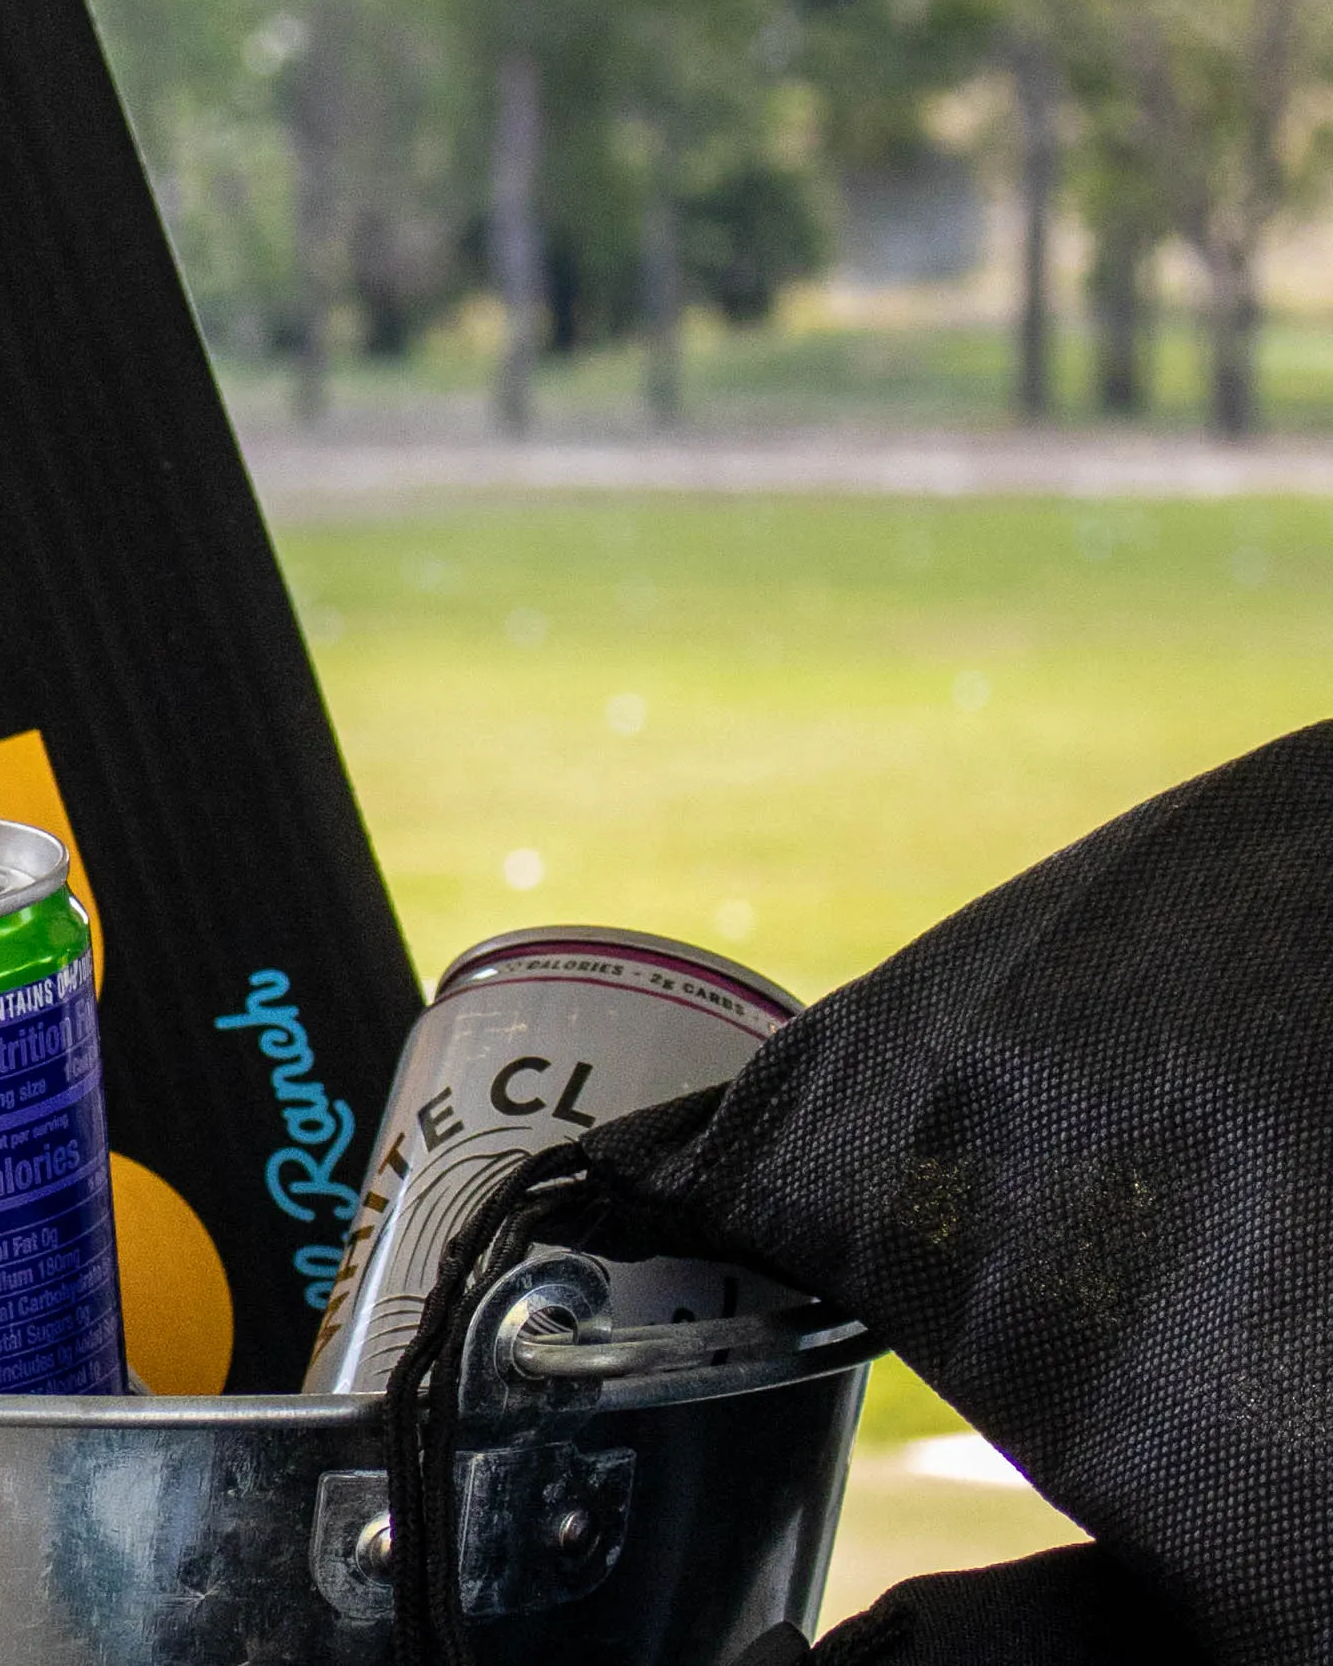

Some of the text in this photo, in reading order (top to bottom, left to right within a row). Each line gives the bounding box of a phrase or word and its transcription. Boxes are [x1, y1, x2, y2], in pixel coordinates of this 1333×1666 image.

[19, 1078, 47, 1102] size
[215, 969, 354, 1221] Ranch
[489, 1055, 599, 1129] CL
[10, 1129, 30, 1150] per
[12, 1232, 39, 1257] Fat
[41, 1226, 59, 1250] 0g
